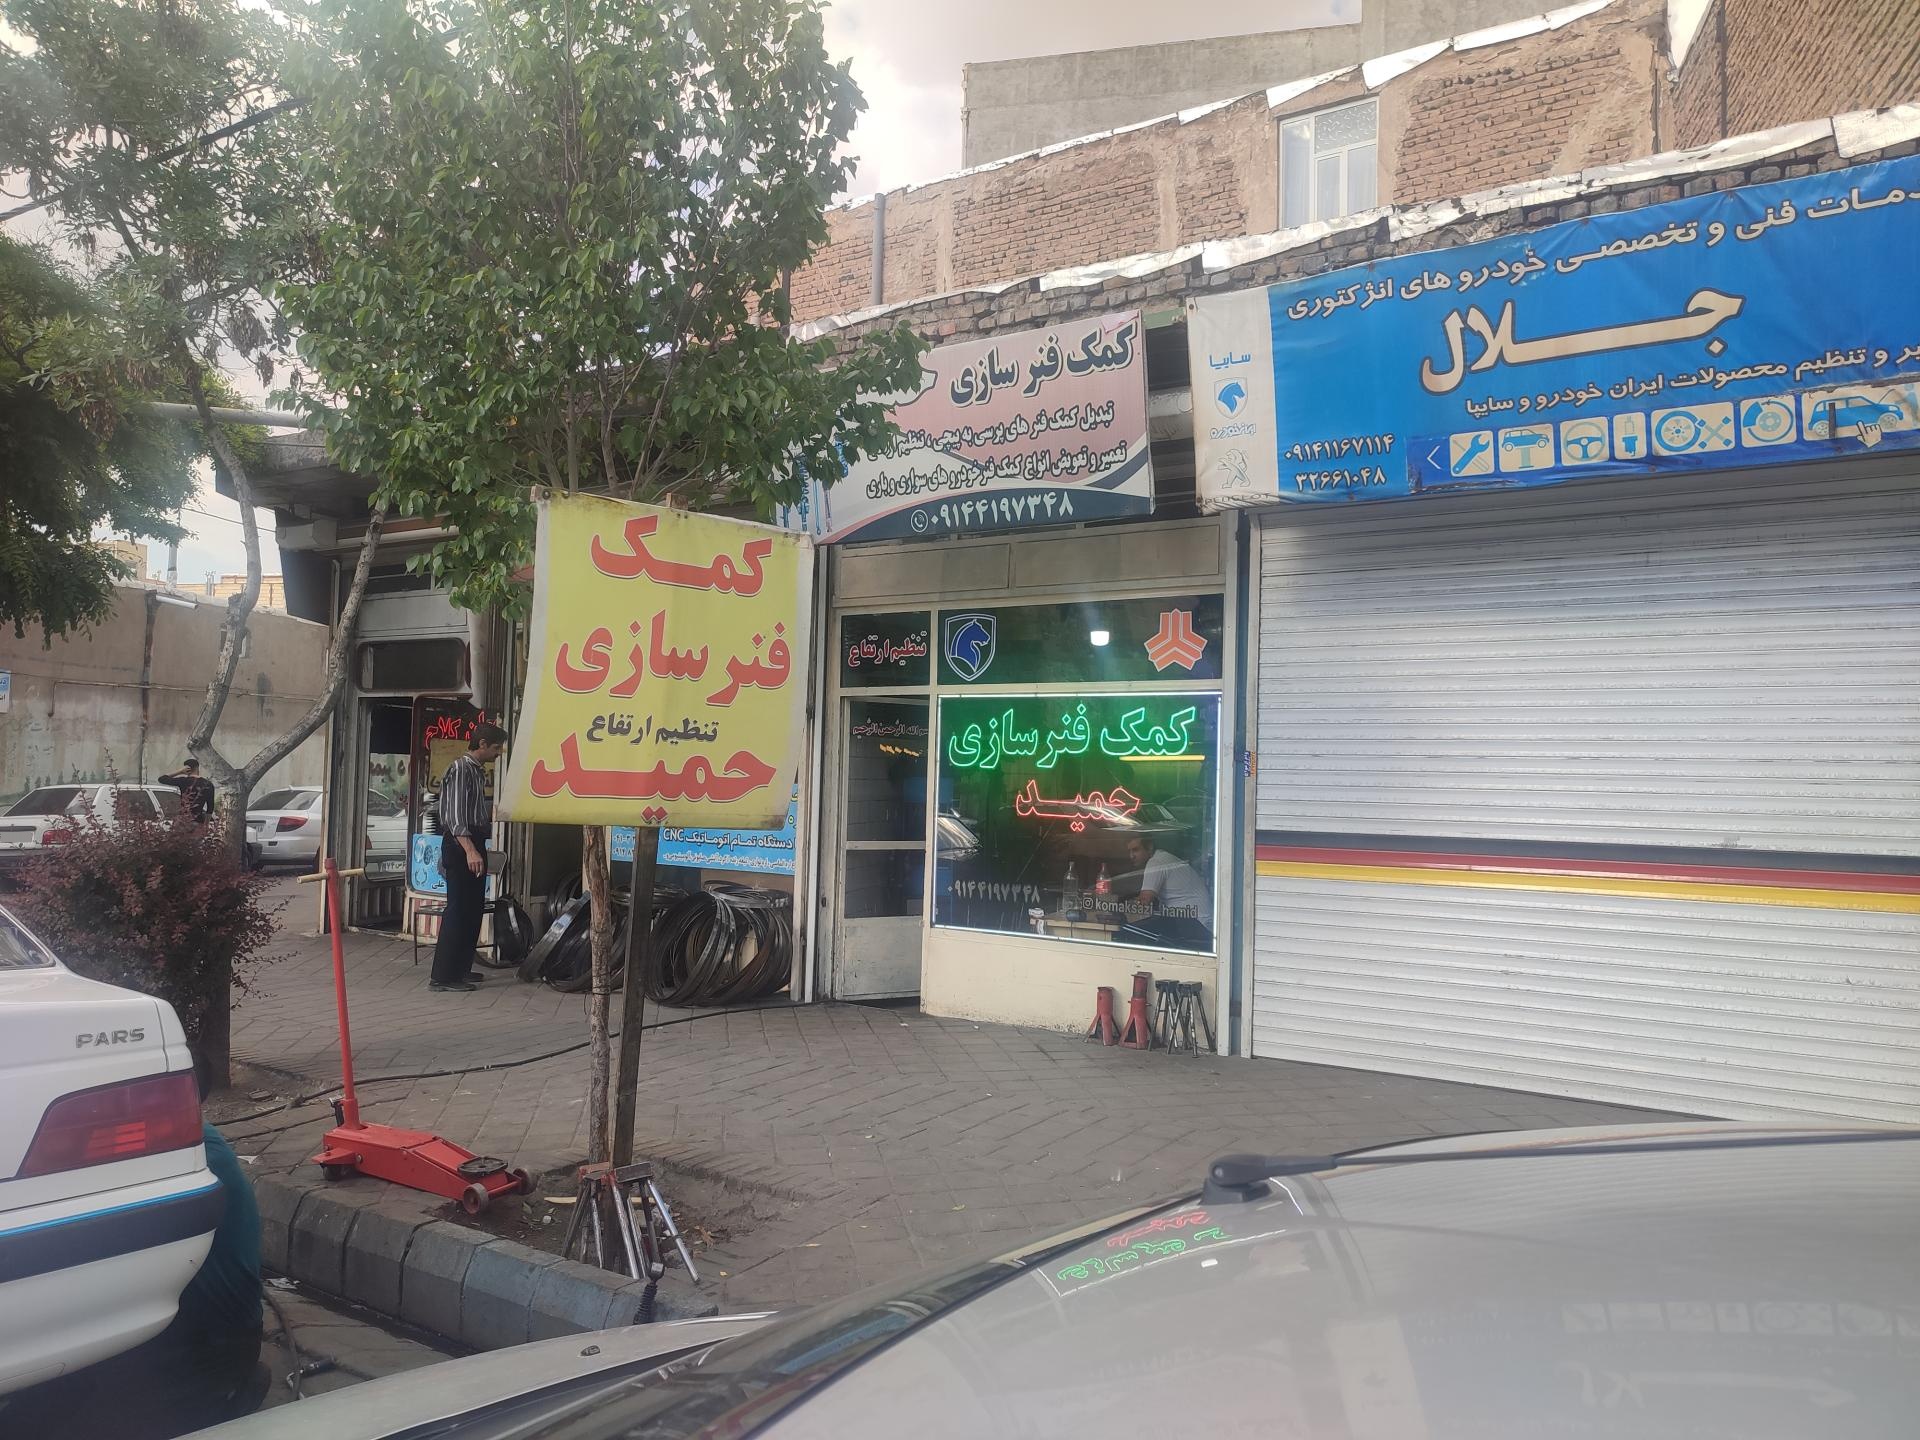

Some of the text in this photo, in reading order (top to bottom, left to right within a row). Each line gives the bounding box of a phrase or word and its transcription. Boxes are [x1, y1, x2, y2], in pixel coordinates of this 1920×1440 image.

[1706, 220, 1726, 247] و
[1735, 200, 1798, 242] فنی
[1555, 219, 1698, 274] تخصصی
[1400, 270, 1451, 300] های
[1457, 249, 1547, 292] خودرو
[1419, 287, 1747, 394] جلال
[950, 320, 1138, 410] کمک فنر سازی
[1795, 348, 1867, 380] تنظیم
[1872, 349, 1888, 369] و
[1608, 374, 1664, 400] ایران
[1669, 363, 1788, 390] محصولات
[1465, 397, 1514, 421] سایپا
[1518, 393, 1531, 413] و
[1536, 382, 1603, 413] خودرو
[1005, 414, 1029, 440] های
[1030, 410, 1048, 439] فنر
[1047, 405, 1079, 431] کمک
[1079, 400, 1115, 431] تبدیل
[898, 429, 926, 458] تنظیم
[961, 426, 973, 447] به
[973, 423, 1005, 446] پرسی
[1283, 433, 1395, 462] ۰۹۱۴۱۱۶۷۱۱۴
[866, 440, 1127, 499] تعمیر و تعویض انواع کمک فنر خودرو های سواری و باری
[1295, 467, 1386, 493] ۳۲۶۶۱۰۴۸
[930, 490, 1074, 528] ۰۹۱۴۴۱۹۷۳۴۸
[590, 514, 773, 597] کمک
[555, 609, 792, 708] فنر سازی
[848, 630, 927, 668] تنظیم ارتفاع
[586, 712, 719, 745] تنظیم ارتفاع
[948, 703, 1196, 769] کمک فنر سازی
[530, 731, 777, 825] حمید
[1015, 779, 1141, 832] حمید
[663, 828, 793, 851] دستگاه تمام اتوماتیک CNC
[75, 1027, 145, 1049] PARS
